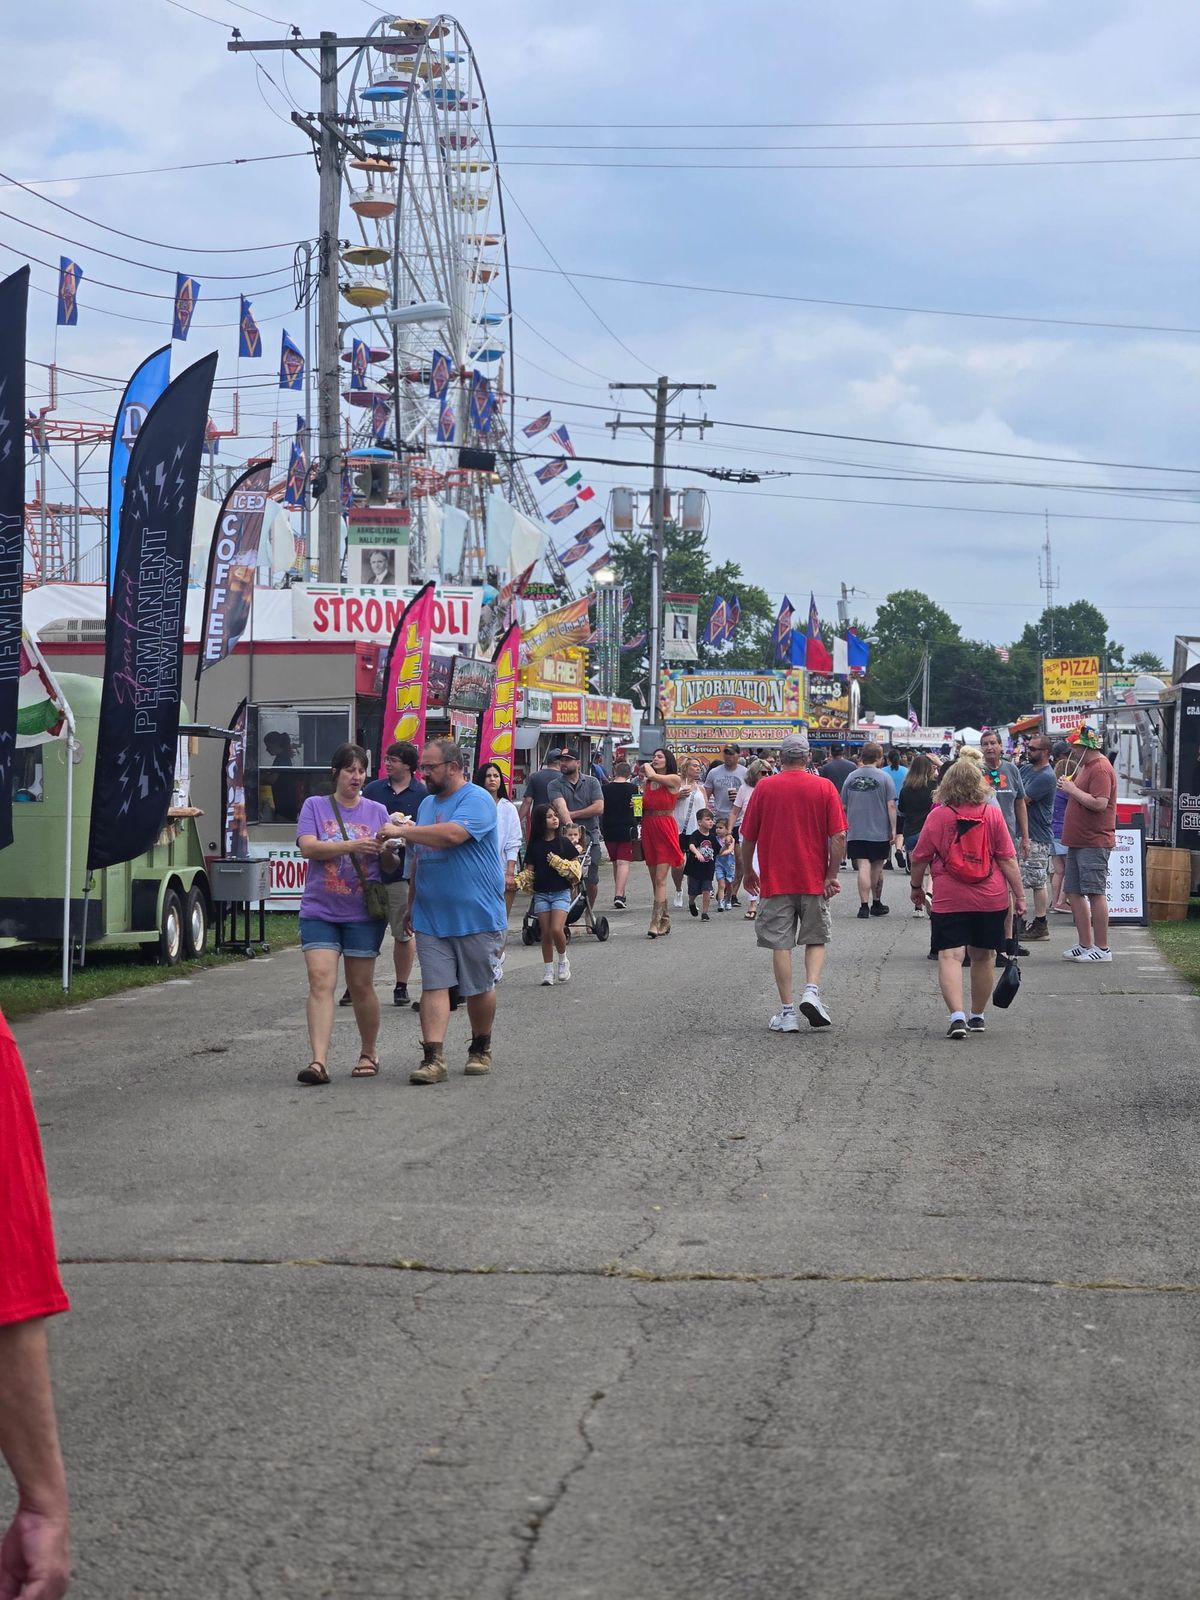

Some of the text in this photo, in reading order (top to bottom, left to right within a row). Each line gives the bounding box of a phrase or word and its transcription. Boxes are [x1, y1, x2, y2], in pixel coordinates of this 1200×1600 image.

[233, 495, 264, 509] ICED
[357, 527, 400, 535] AGRICULTURAL
[383, 536, 398, 544] FAME
[206, 515, 238, 660] COFFEE
[313, 597, 469, 635] STROMOLI
[134, 527, 168, 734] PERMANENT
[158, 555, 184, 703] JEWELRY
[1060, 659, 1099, 676] PIZZA
[393, 621, 424, 750] LEMO
[674, 680, 785, 712] INFORMATION
[557, 701, 578, 711] DOGS
[1051, 705, 1091, 713] GOURMET
[556, 712, 579, 723] RINGS
[665, 727, 793, 739] WRISTBAND STATION
[667, 745, 720, 753] Guest Services
[1119, 855, 1134, 864] $13
[1120, 868, 1134, 877] $25
[1120, 881, 1135, 889] $35
[1120, 893, 1135, 902] $55
